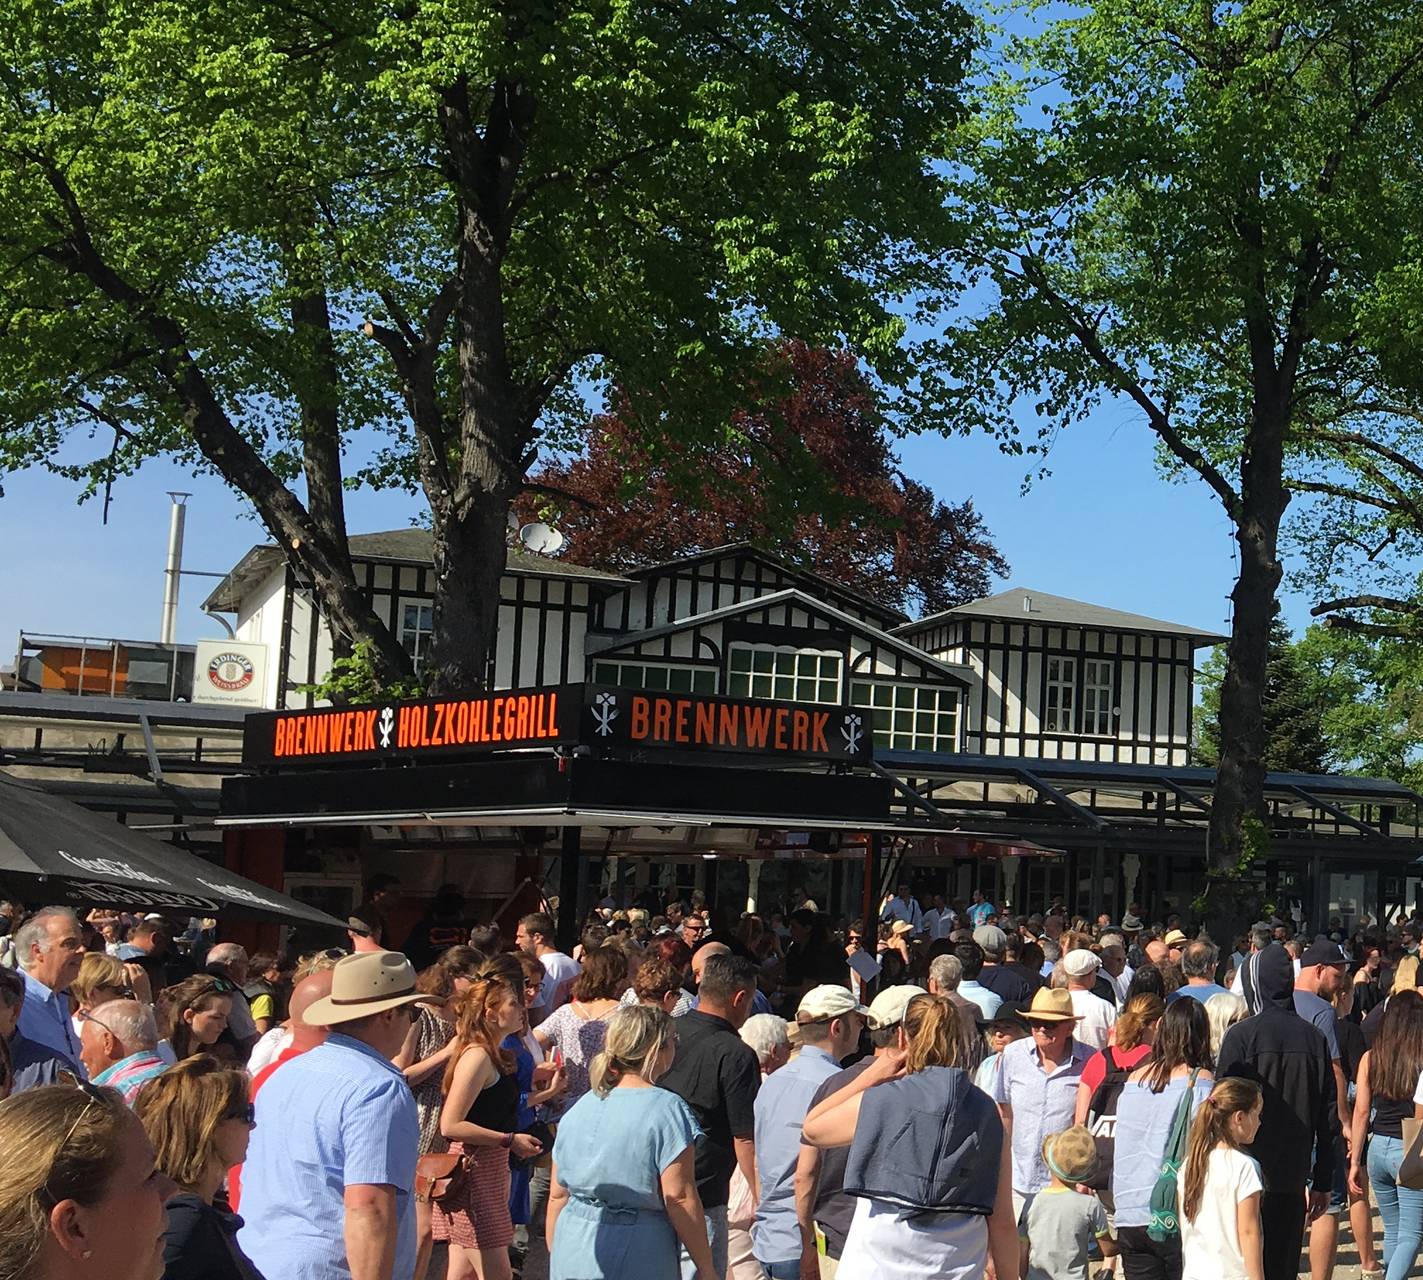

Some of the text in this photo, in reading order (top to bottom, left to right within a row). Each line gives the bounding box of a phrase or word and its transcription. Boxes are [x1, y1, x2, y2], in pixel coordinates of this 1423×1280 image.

[210, 653, 252, 670] ERDINGER
[274, 693, 558, 756] BRENNWERK HOLZKOHLEGRILL
[631, 696, 829, 752] BRENNWERK
